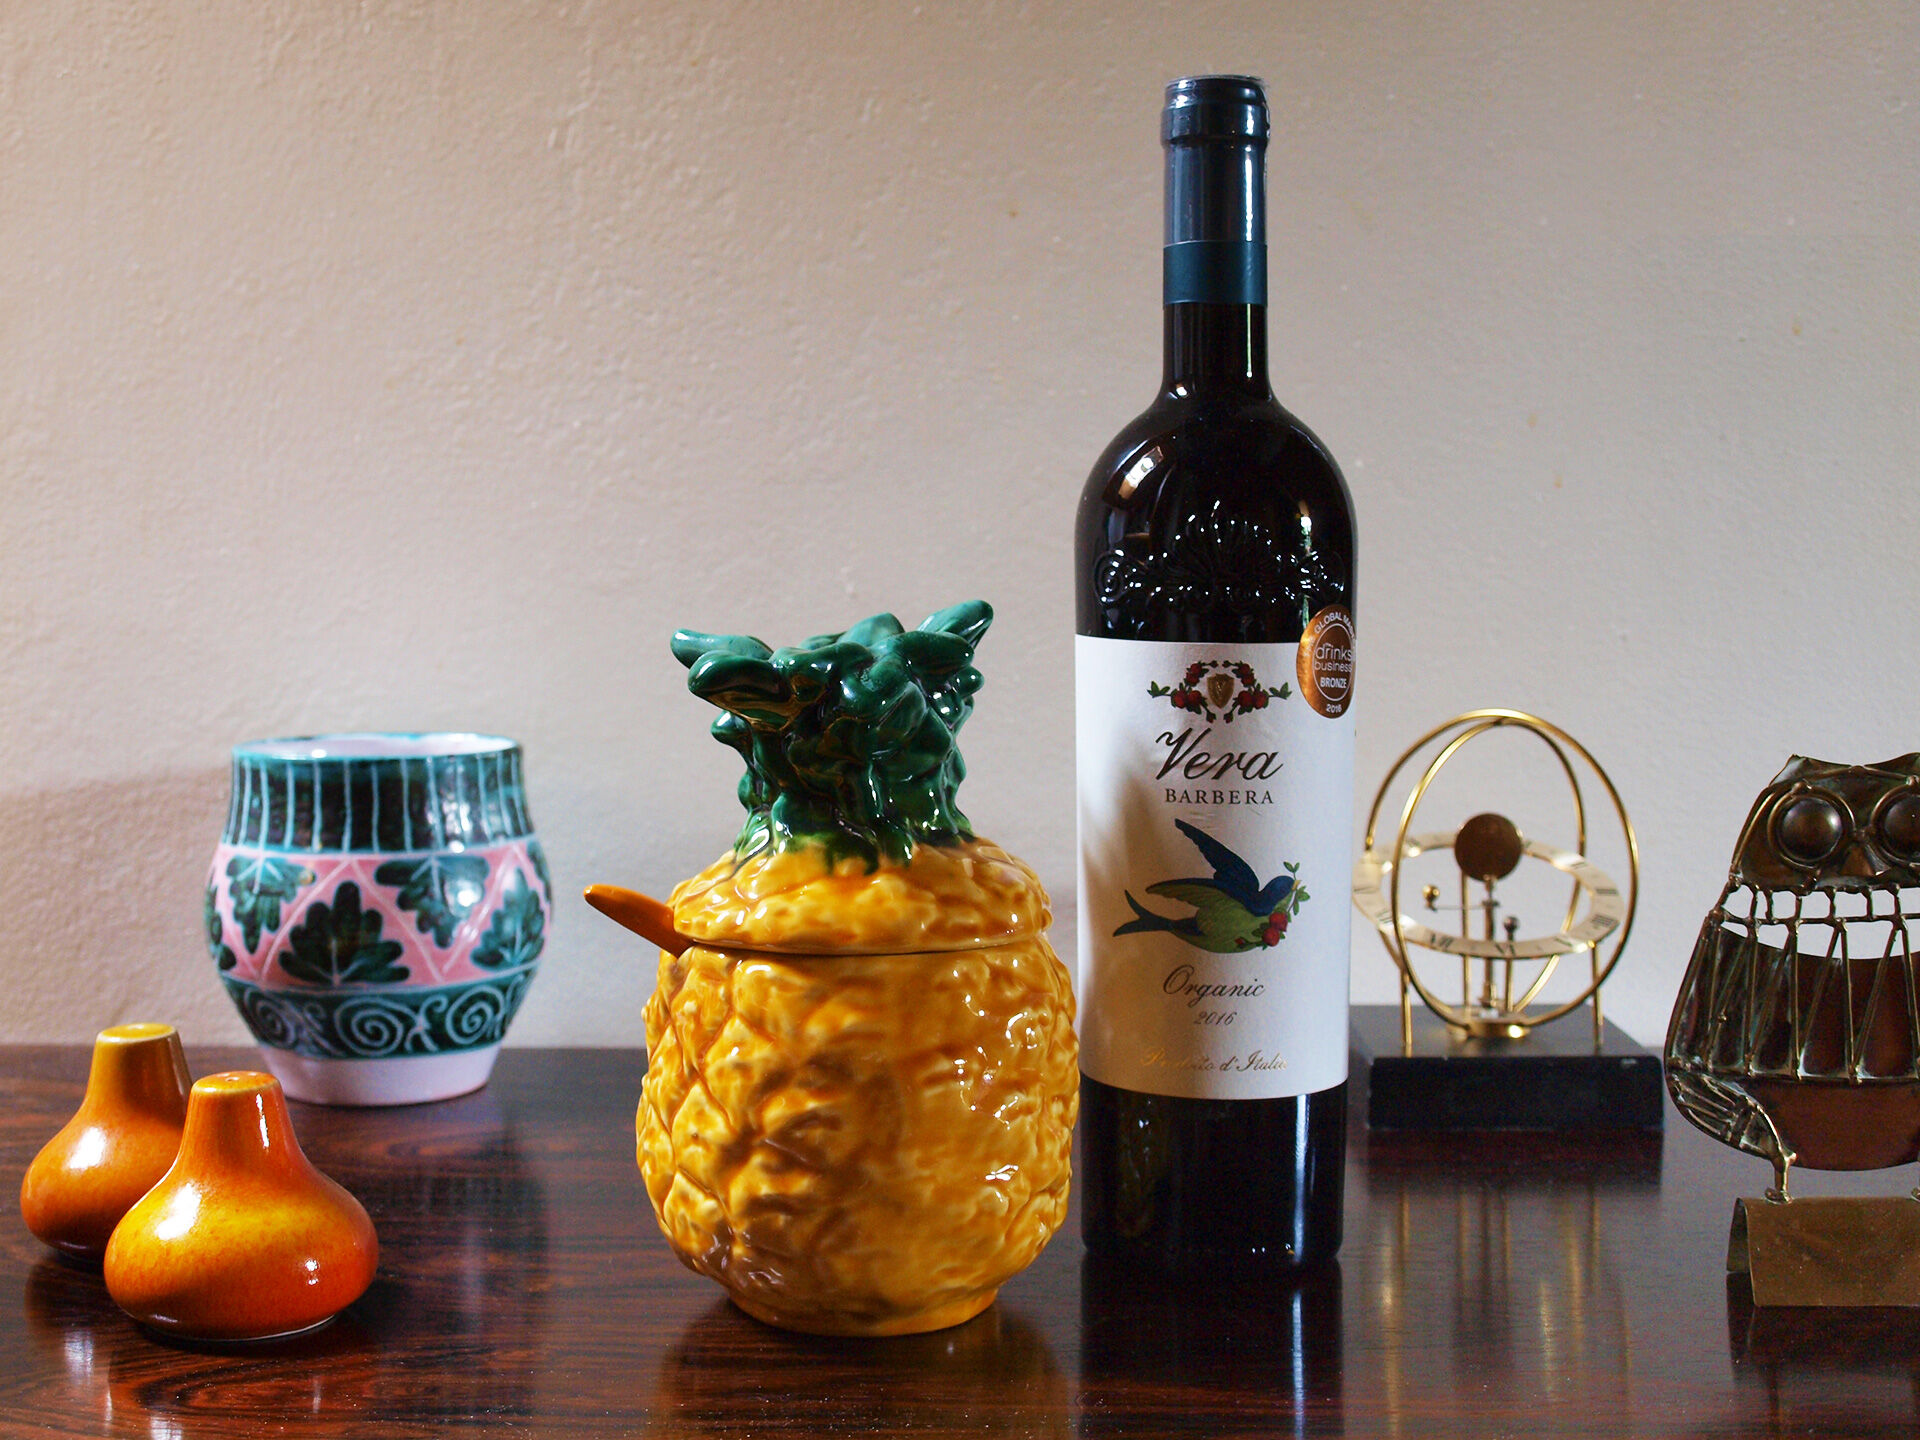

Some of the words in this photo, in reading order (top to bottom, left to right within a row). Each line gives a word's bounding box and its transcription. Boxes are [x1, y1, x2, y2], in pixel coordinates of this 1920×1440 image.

[1313, 611, 1342, 634] GLOBAL
[1316, 643, 1353, 661] drinks
[1314, 660, 1352, 673] business
[1319, 676, 1347, 688] BRONZE
[1155, 727, 1283, 781] Vera
[1164, 787, 1275, 805] BARBERA
[1162, 963, 1266, 1008] Organic
[1193, 1011, 1238, 1026] 2016
